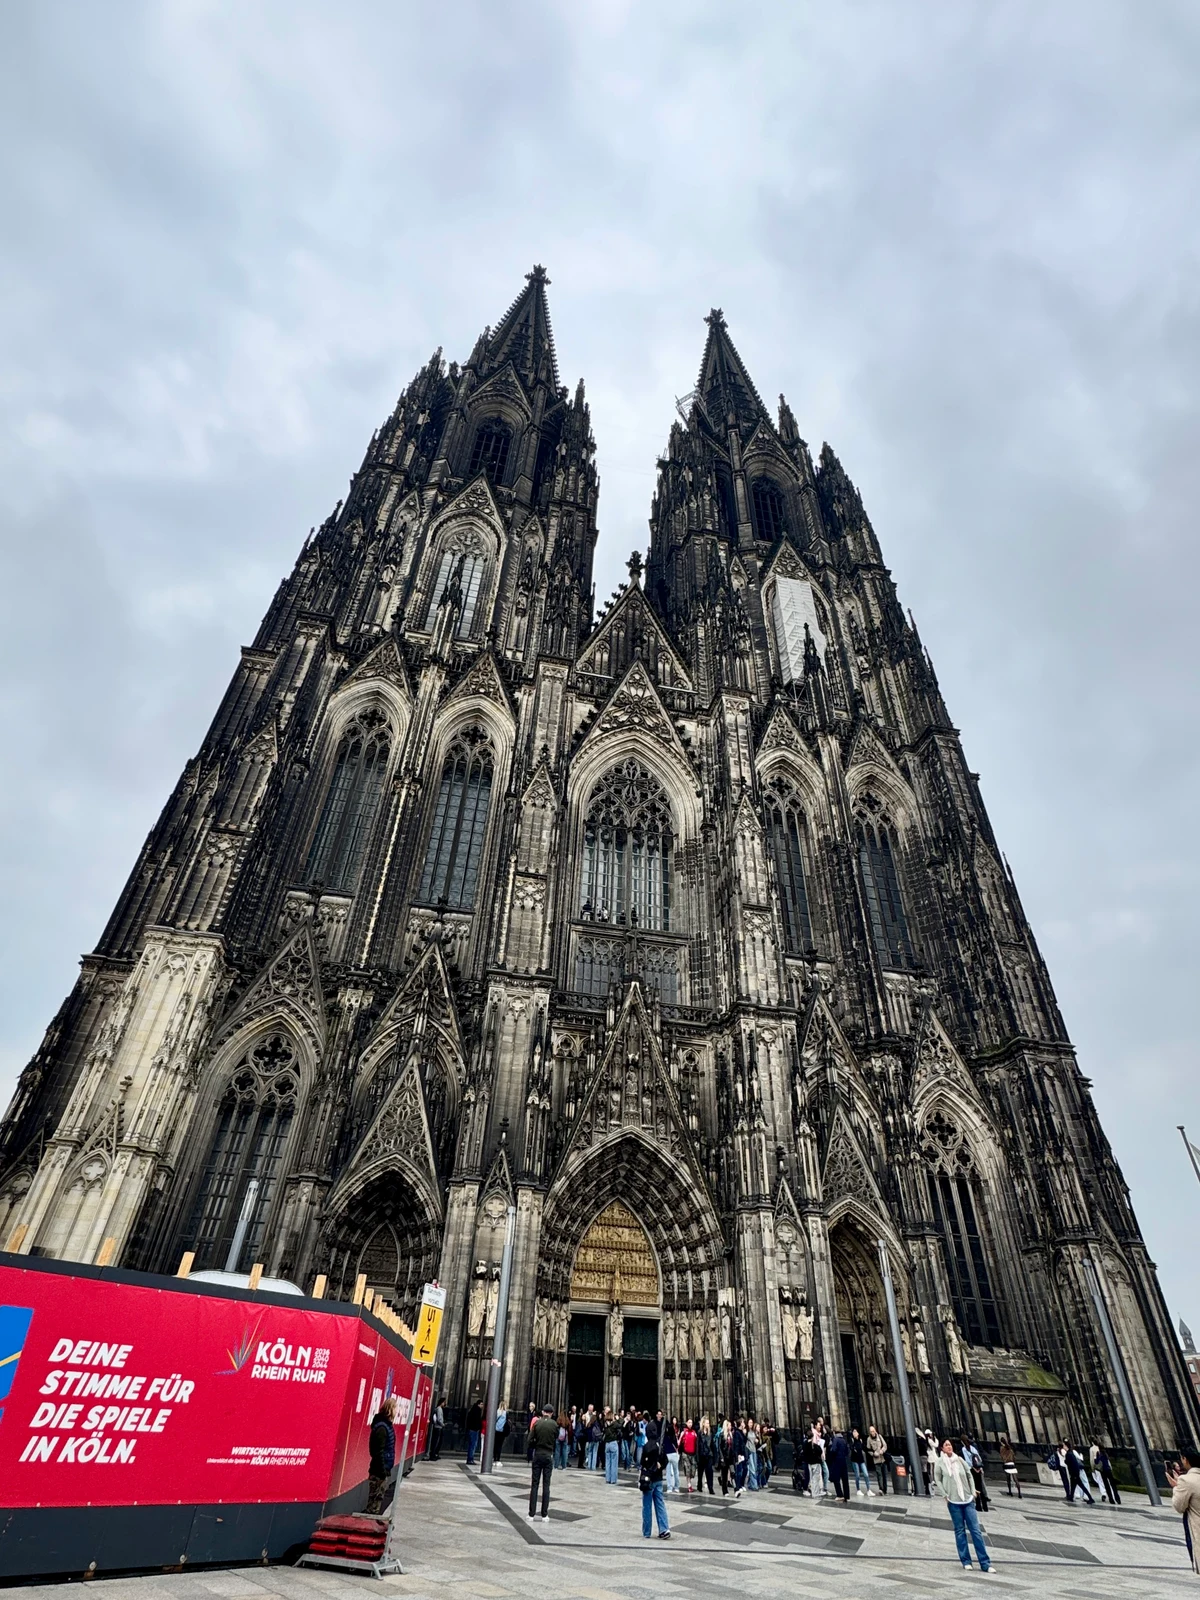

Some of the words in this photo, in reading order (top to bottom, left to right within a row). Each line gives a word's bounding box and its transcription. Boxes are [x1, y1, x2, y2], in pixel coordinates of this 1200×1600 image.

[47, 1338, 134, 1368] DEINE
[255, 1338, 312, 1367] KÖLN
[315, 1348, 330, 1356] 2036
[39, 1369, 147, 1400] STIMME
[144, 1373, 195, 1404] FÜR
[251, 1364, 292, 1381] RHEIN
[292, 1368, 326, 1384] RUHR
[29, 1402, 83, 1430] DIE
[81, 1405, 173, 1434] SPIELE
[19, 1435, 59, 1463] IN
[56, 1432, 138, 1464] KÖLN.
[231, 1447, 310, 1457] WIRTSCHAFTSINITIATIVE
[250, 1455, 270, 1466] KÖLN
[269, 1456, 290, 1466] RHEIN
[289, 1457, 307, 1465] RUHR
